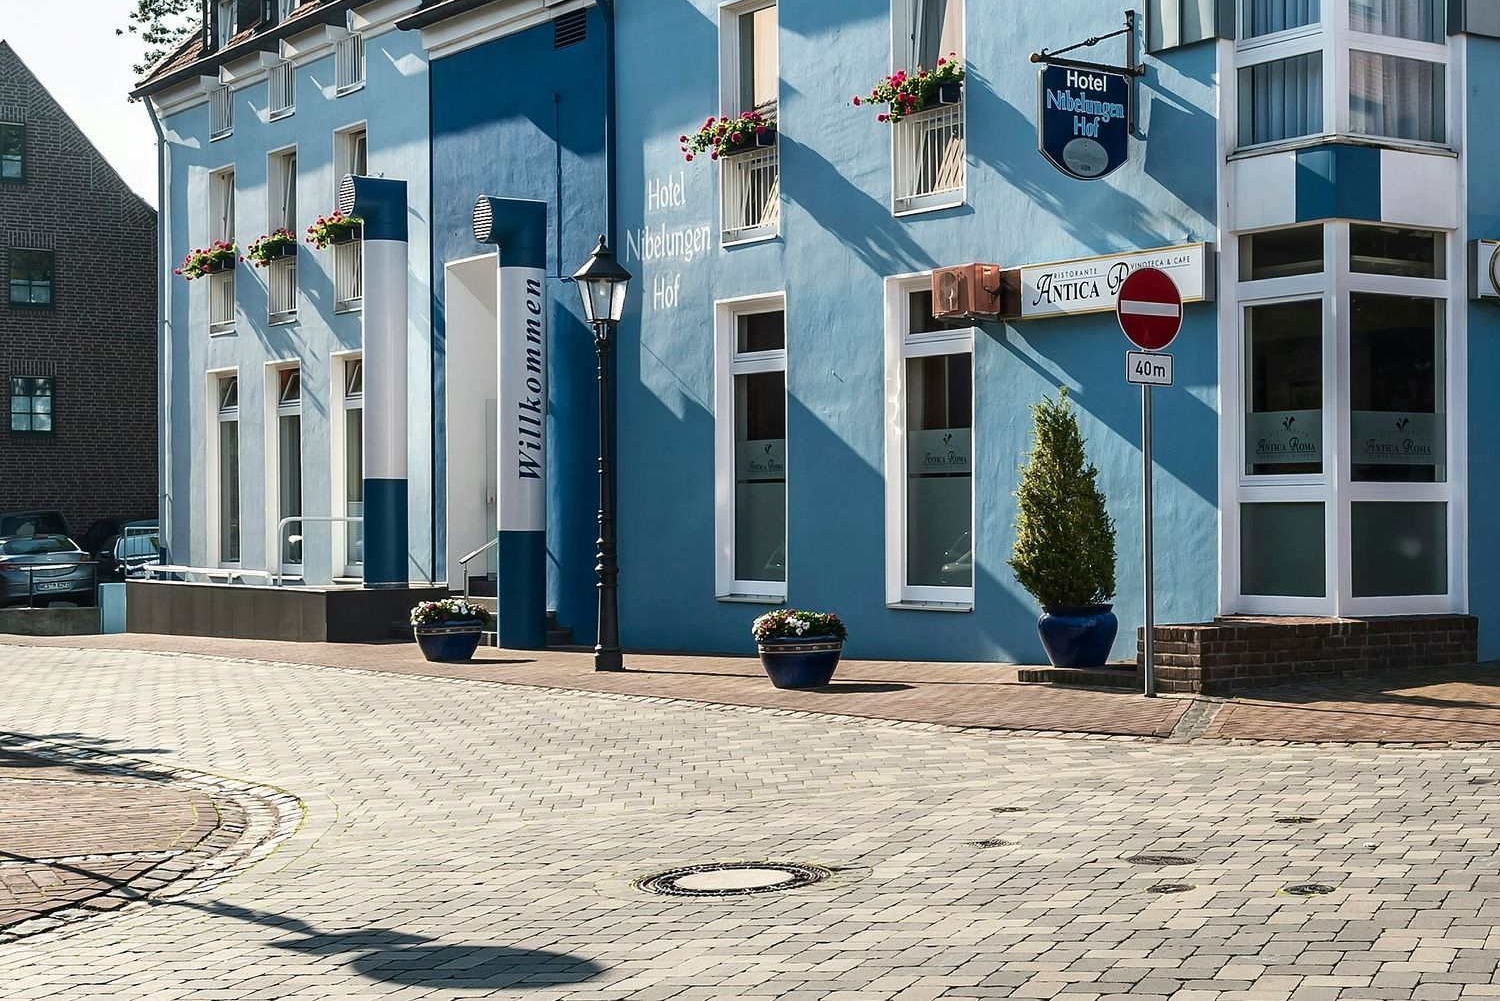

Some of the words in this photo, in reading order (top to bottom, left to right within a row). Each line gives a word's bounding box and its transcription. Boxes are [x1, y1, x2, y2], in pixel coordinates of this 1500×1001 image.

[1067, 70, 1106, 92] Hotel
[1046, 88, 1124, 123] Nibelungen
[1073, 115, 1100, 137] Hof
[648, 171, 686, 211] Hotel
[626, 223, 711, 263] Nibelungen
[1054, 268, 1097, 279] RISTORANTE
[1131, 259, 1163, 270] VINOTECA
[653, 274, 680, 310] Hof
[1032, 273, 1100, 306] ANTICA
[518, 277, 542, 480] Willkommen
